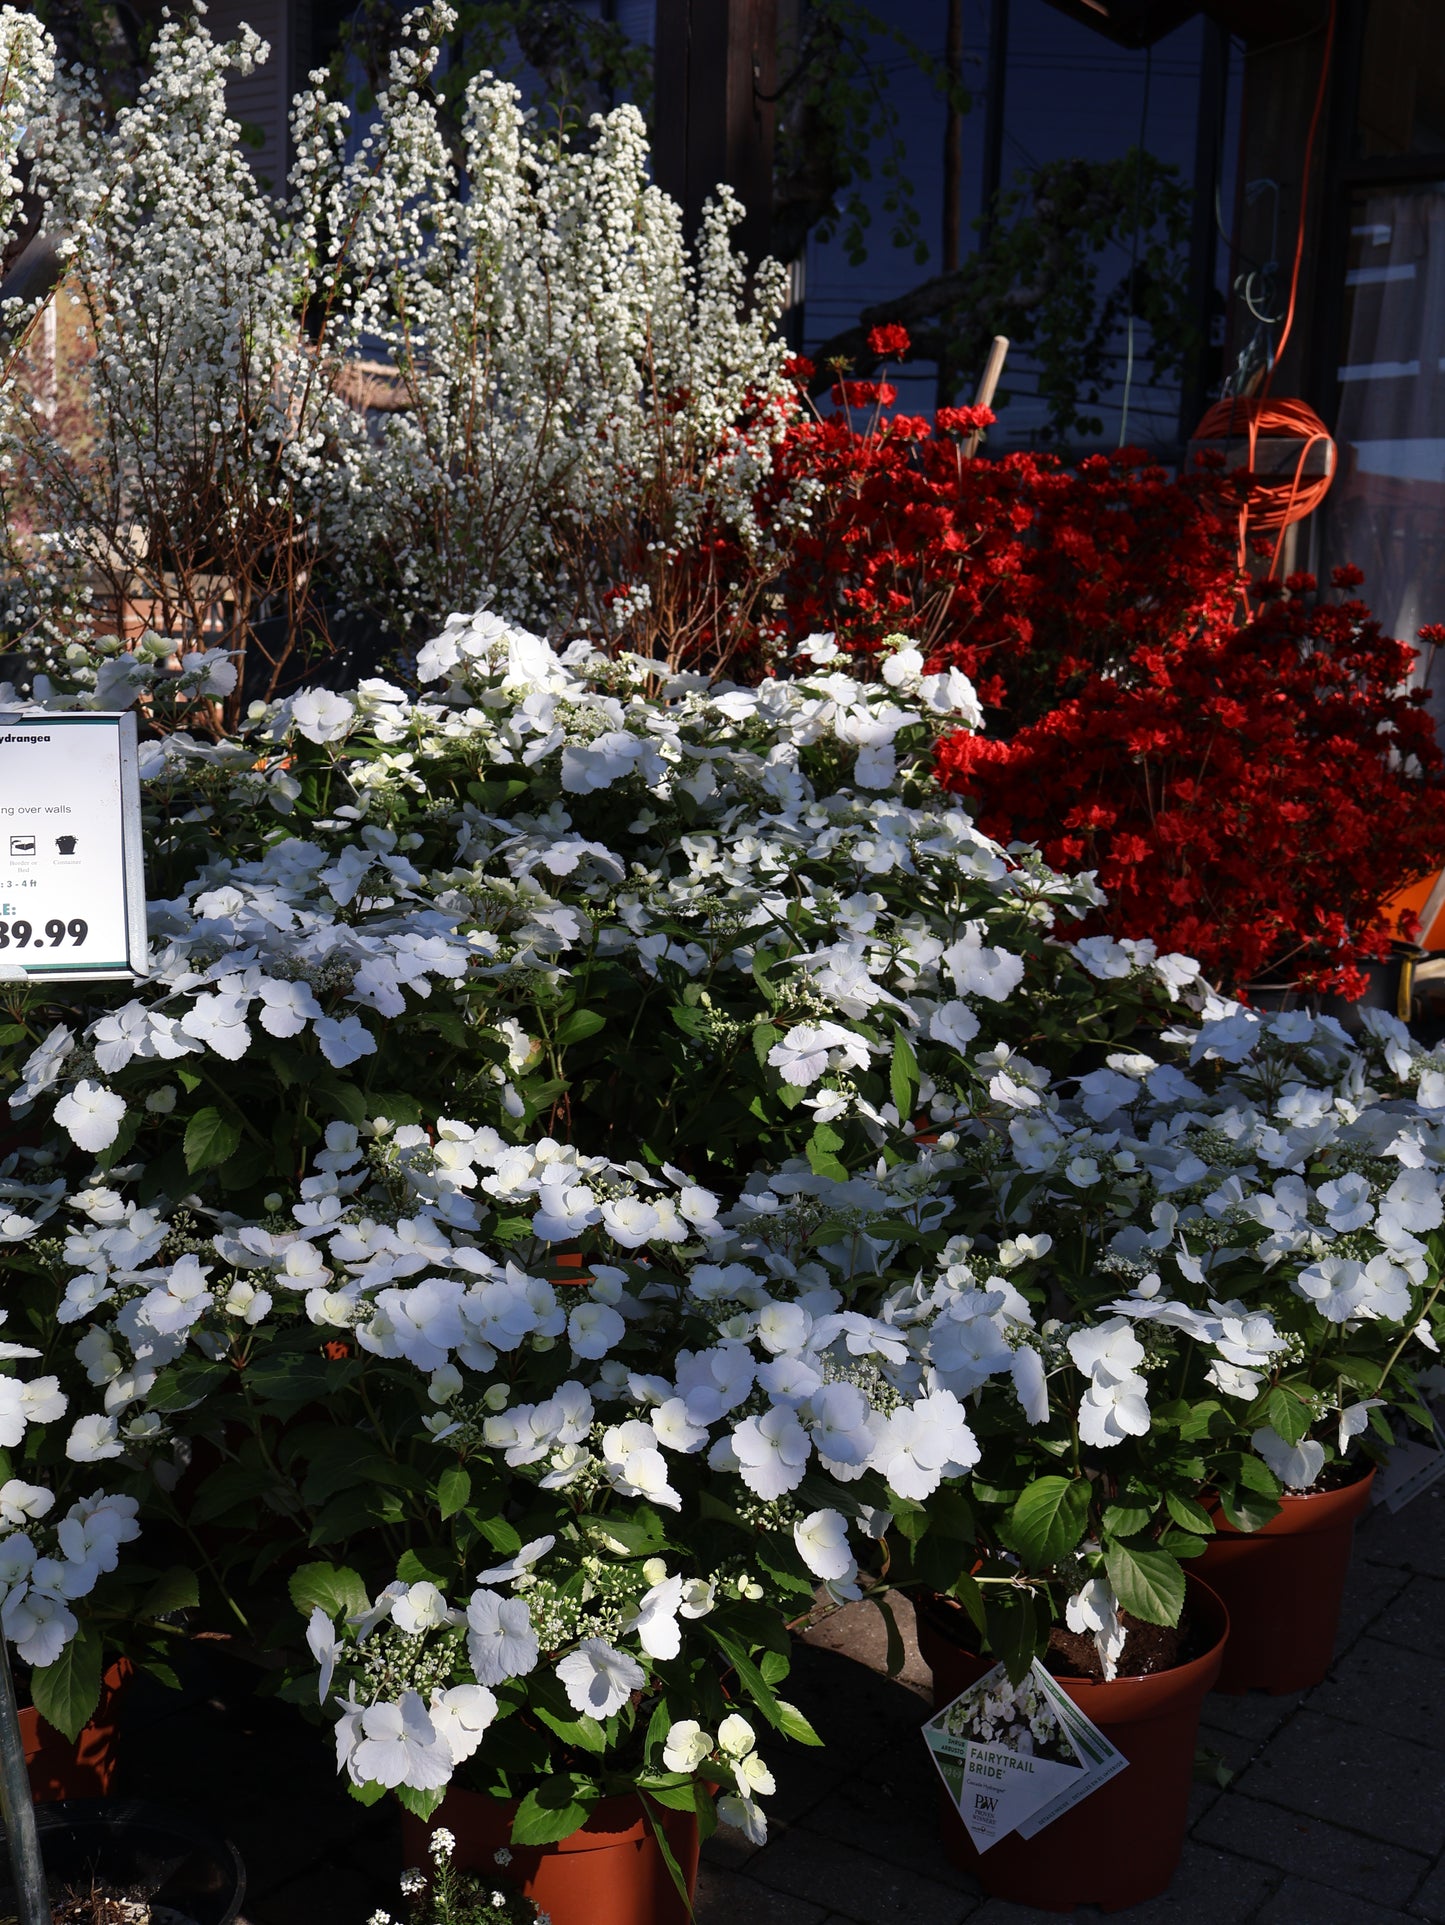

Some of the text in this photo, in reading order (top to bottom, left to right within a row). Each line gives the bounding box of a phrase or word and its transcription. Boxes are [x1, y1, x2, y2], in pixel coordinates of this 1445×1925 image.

[1, 807, 15, 816] ng
[45, 805, 72, 814] walls
[6, 880, 13, 888] 3
[29, 879, 38, 887] ft
[0, 903, 16, 916] E:
[970, 1748, 1035, 1773] FAIRYTRAIL
